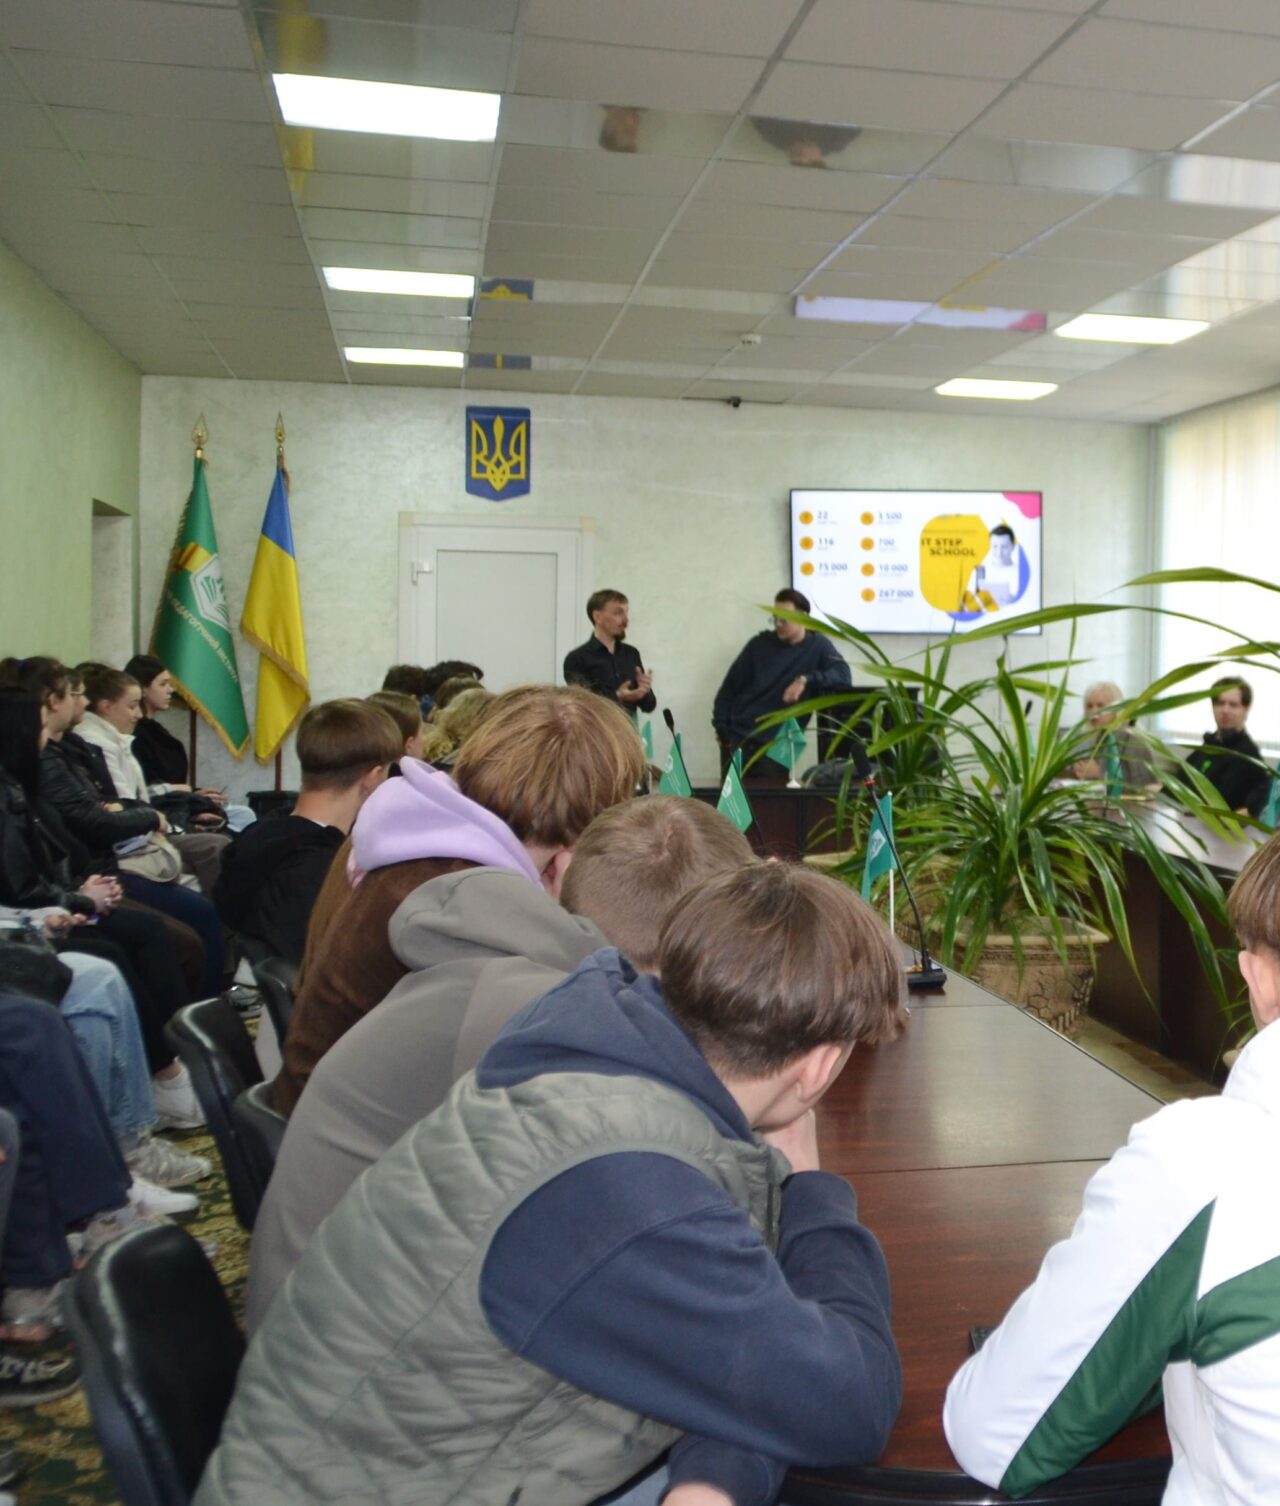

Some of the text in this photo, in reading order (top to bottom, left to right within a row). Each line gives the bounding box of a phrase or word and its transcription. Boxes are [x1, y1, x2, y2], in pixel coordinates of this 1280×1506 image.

[921, 538, 963, 546] IT STEP
[930, 548, 976, 556] SCHOOL
[831, 563, 848, 572] 000
[891, 563, 908, 572] 000
